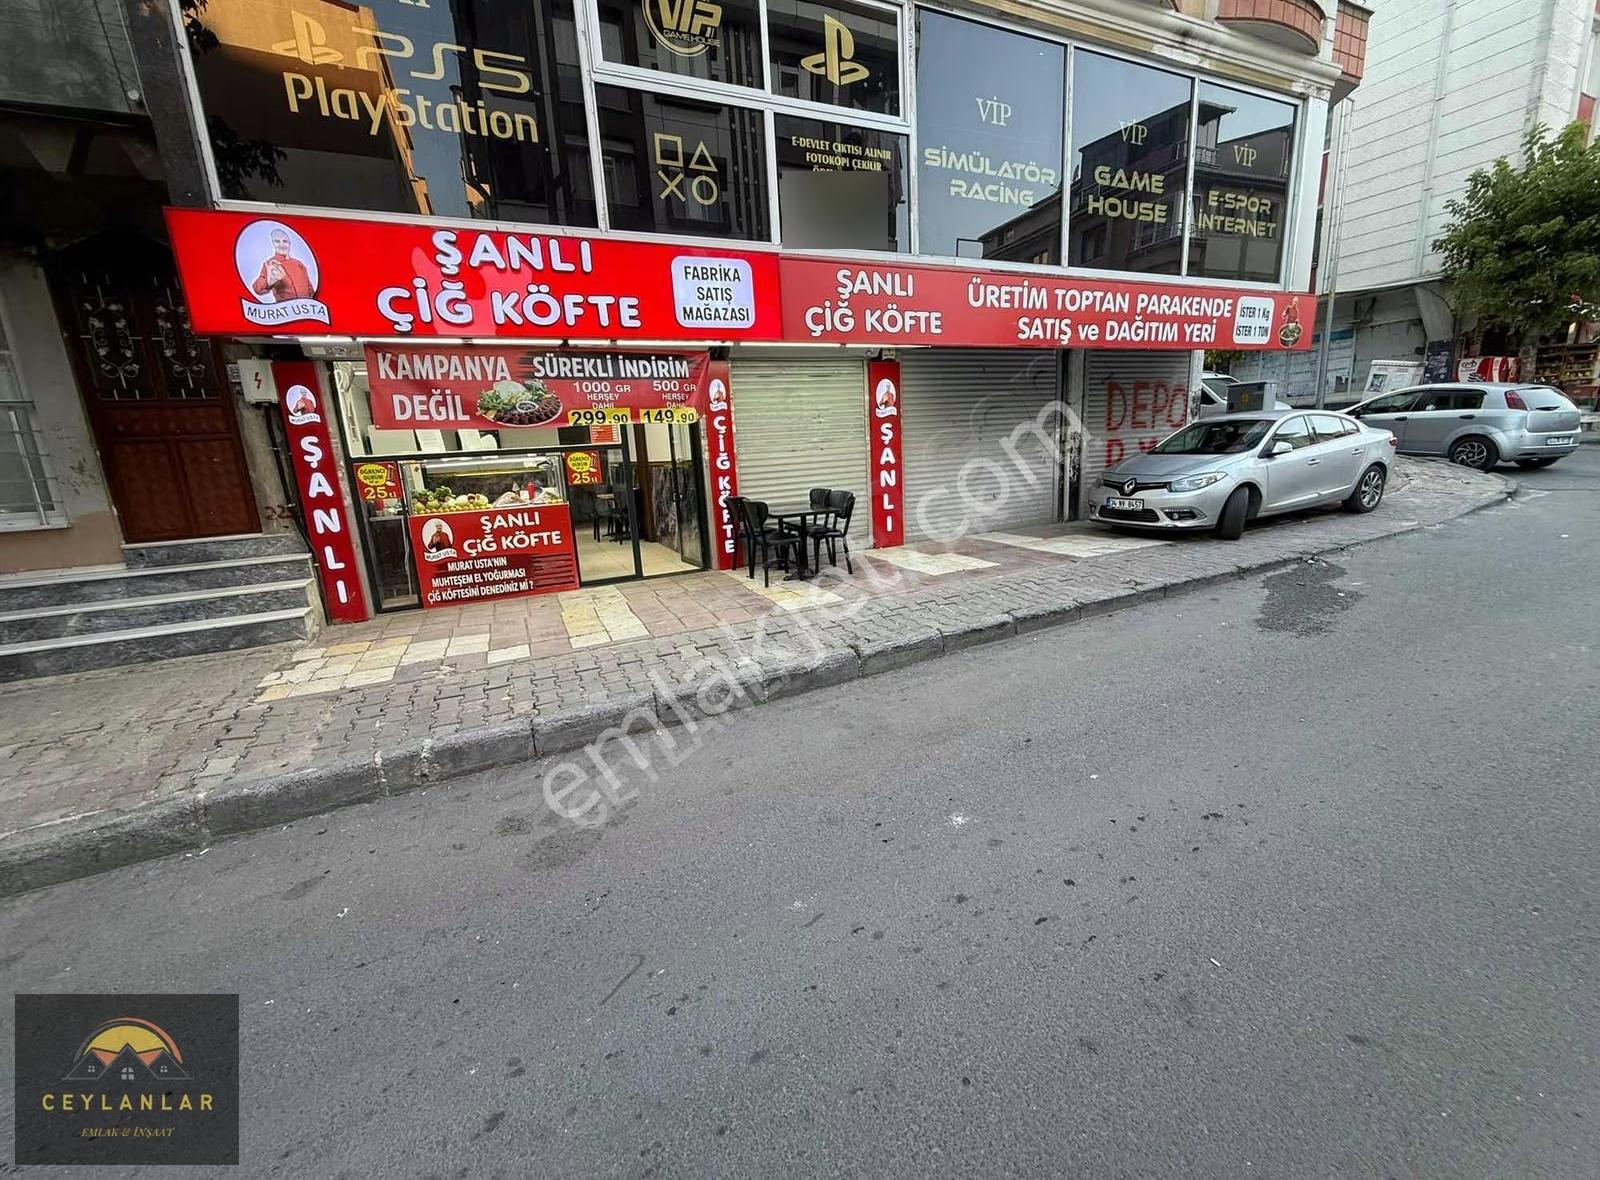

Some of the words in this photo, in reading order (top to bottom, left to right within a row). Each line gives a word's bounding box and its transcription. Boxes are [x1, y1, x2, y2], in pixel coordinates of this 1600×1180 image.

[352, 25, 531, 94] PS5
[283, 71, 539, 144] PlayStation
[976, 96, 1012, 127] VİP
[1119, 119, 1148, 147] VİP
[792, 136, 830, 151] E-DEVLET
[833, 142, 862, 156] ÇIKTISI
[865, 147, 892, 160] ALINIR
[806, 152, 850, 168] FOTOKOPİ
[1233, 142, 1257, 168] VİP
[924, 144, 1057, 185] SİMÜLATÖR
[950, 176, 1034, 208] RACİNG
[1094, 165, 1166, 195] GAME
[1088, 196, 1168, 225] HOUSE
[1208, 189, 1271, 215] E-SPOR
[1199, 207, 1277, 238] İNTERNET
[431, 229, 593, 276] ŞANLI
[684, 264, 742, 282] FABRİKA
[836, 269, 914, 300] ŞANLI
[376, 277, 474, 333] ÇİĞ
[491, 284, 643, 328] KÖFTE
[697, 286, 733, 305] SATIŞ
[967, 276, 1048, 310] ÜRETİM
[1055, 288, 1130, 312] TOPTAN
[1137, 293, 1232, 318] PARAKENDE
[247, 306, 289, 320] MURAT
[291, 304, 327, 316] USTA
[682, 303, 750, 322] MAĞAZASI
[804, 300, 855, 337] ÇİĞ
[864, 303, 943, 334] KÖFTE
[1240, 303, 1256, 318] İSTER
[1262, 308, 1270, 321] Kg
[1018, 316, 1072, 345] SATIŞ
[1078, 323, 1099, 341] ve
[1105, 315, 1179, 343] DAĞITIM
[1184, 319, 1217, 343] YERİ
[1236, 322, 1252, 337] İSTER
[376, 352, 512, 381] KAMPANYA
[533, 352, 614, 379] SÜREKLİ
[618, 354, 690, 379] İNDİRİM
[573, 381, 611, 393] 1000
[615, 384, 632, 393] GR
[587, 393, 620, 401] HERŞEY
[653, 380, 679, 392] 500
[683, 384, 697, 392] GR
[662, 392, 690, 401] HERŞEY
[392, 389, 470, 422] DEĞİL
[571, 410, 628, 426] 299.90
[643, 409, 695, 424] 149.90
[1106, 382, 1187, 431] DEPO
[713, 416, 731, 470] ÇİĞ
[880, 422, 897, 532] ŞANLI
[300, 435, 348, 604] ŞANLI
[480, 511, 540, 534] ŞANLI
[463, 534, 497, 557] ÇİĞ
[501, 530, 562, 550] KÖFTE
[432, 574, 473, 588] MUHTEŞEM
[475, 573, 483, 583] EL
[483, 568, 526, 581] YOĞURMASI
[447, 560, 473, 572] MURAT
[474, 557, 507, 570] USTA'NIN
[442, 585, 480, 600] KÖFTESİNİ
[481, 580, 519, 596] DENEDİNİZ
[520, 579, 529, 590] Mİ
